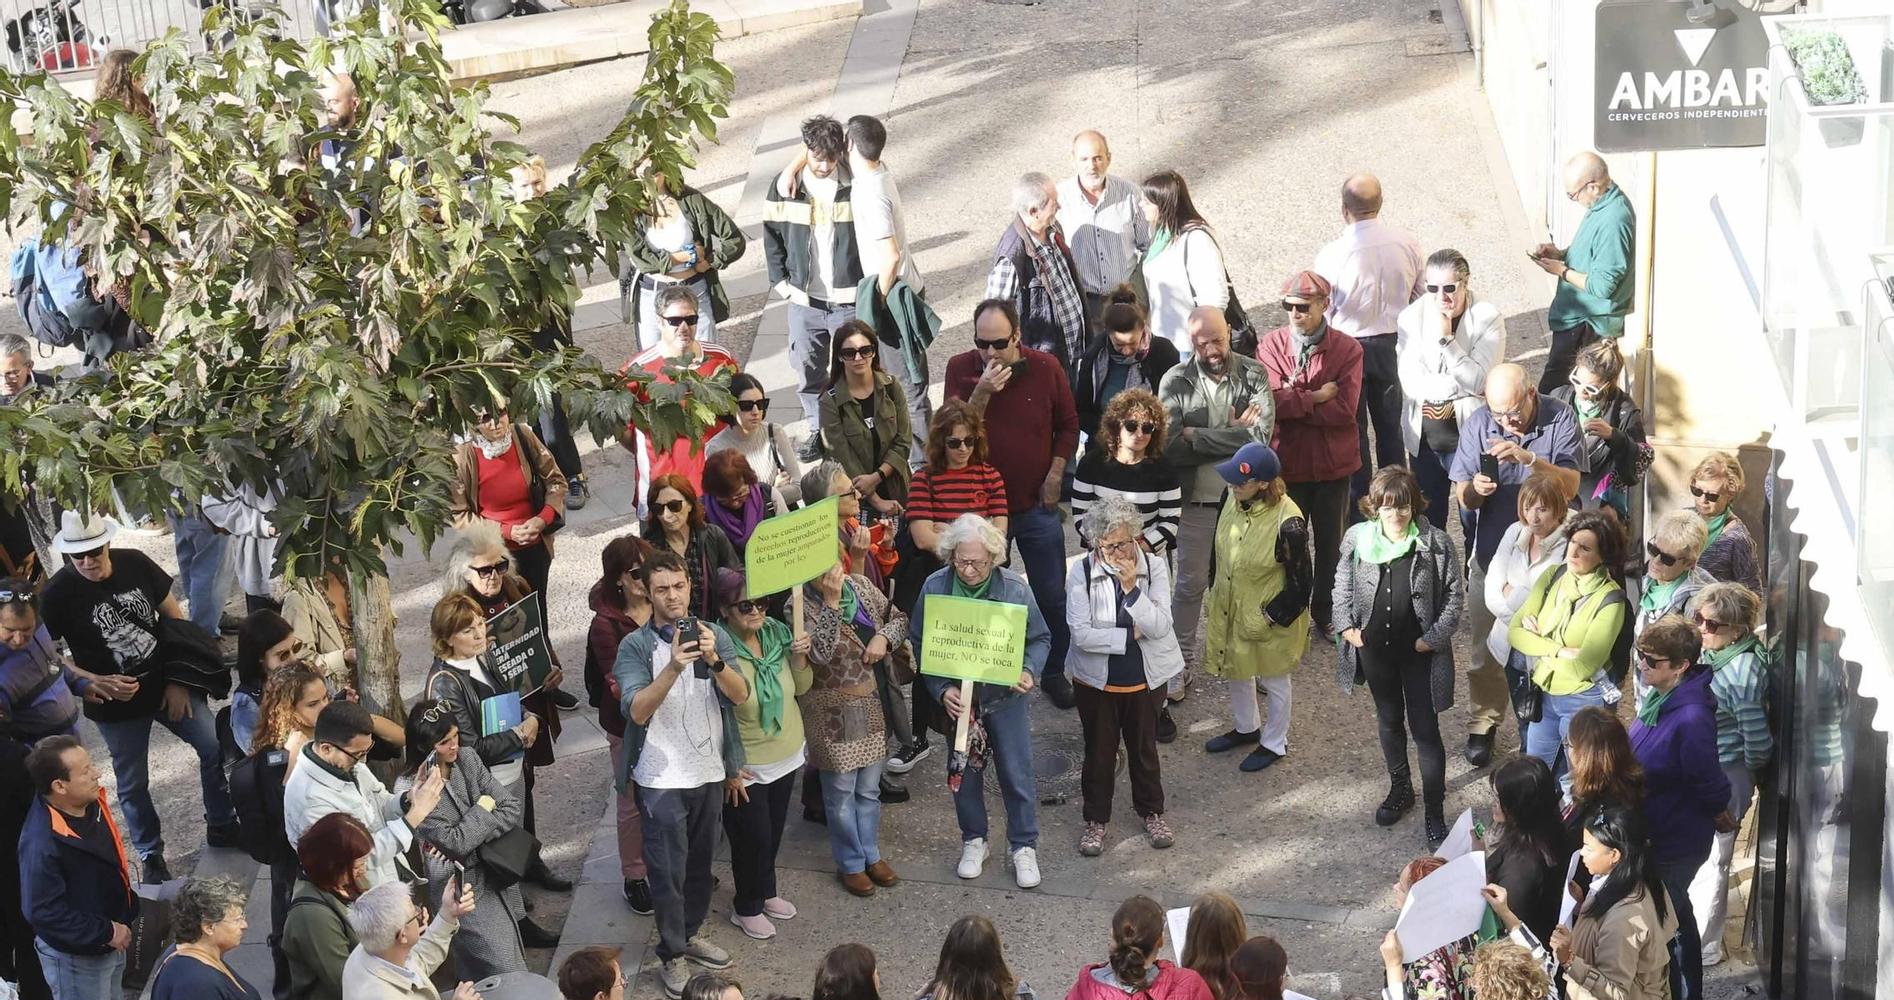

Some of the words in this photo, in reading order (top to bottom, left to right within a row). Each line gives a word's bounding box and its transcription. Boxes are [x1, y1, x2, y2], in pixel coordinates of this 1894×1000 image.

[1608, 67, 1769, 110] AMBAR
[1608, 111, 1681, 122] CERVECEROS
[757, 535, 770, 543] No
[781, 519, 817, 537] cuestionan
[818, 513, 829, 521] los
[754, 540, 787, 554] derechos
[788, 523, 832, 544] reproductivos
[756, 556, 766, 564] de
[776, 546, 797, 559] mujer
[783, 558, 795, 568] por
[935, 620, 947, 630] La
[948, 623, 973, 634] salud
[975, 626, 1006, 638] sexual
[1008, 632, 1014, 642] y
[931, 636, 990, 650] reproductiva
[991, 642, 1004, 653] de
[1005, 643, 1015, 653] la
[498, 652, 528, 674] ESEADA
[960, 652, 978, 663] NO
[979, 656, 991, 664] se
[992, 656, 1015, 668] toca.
